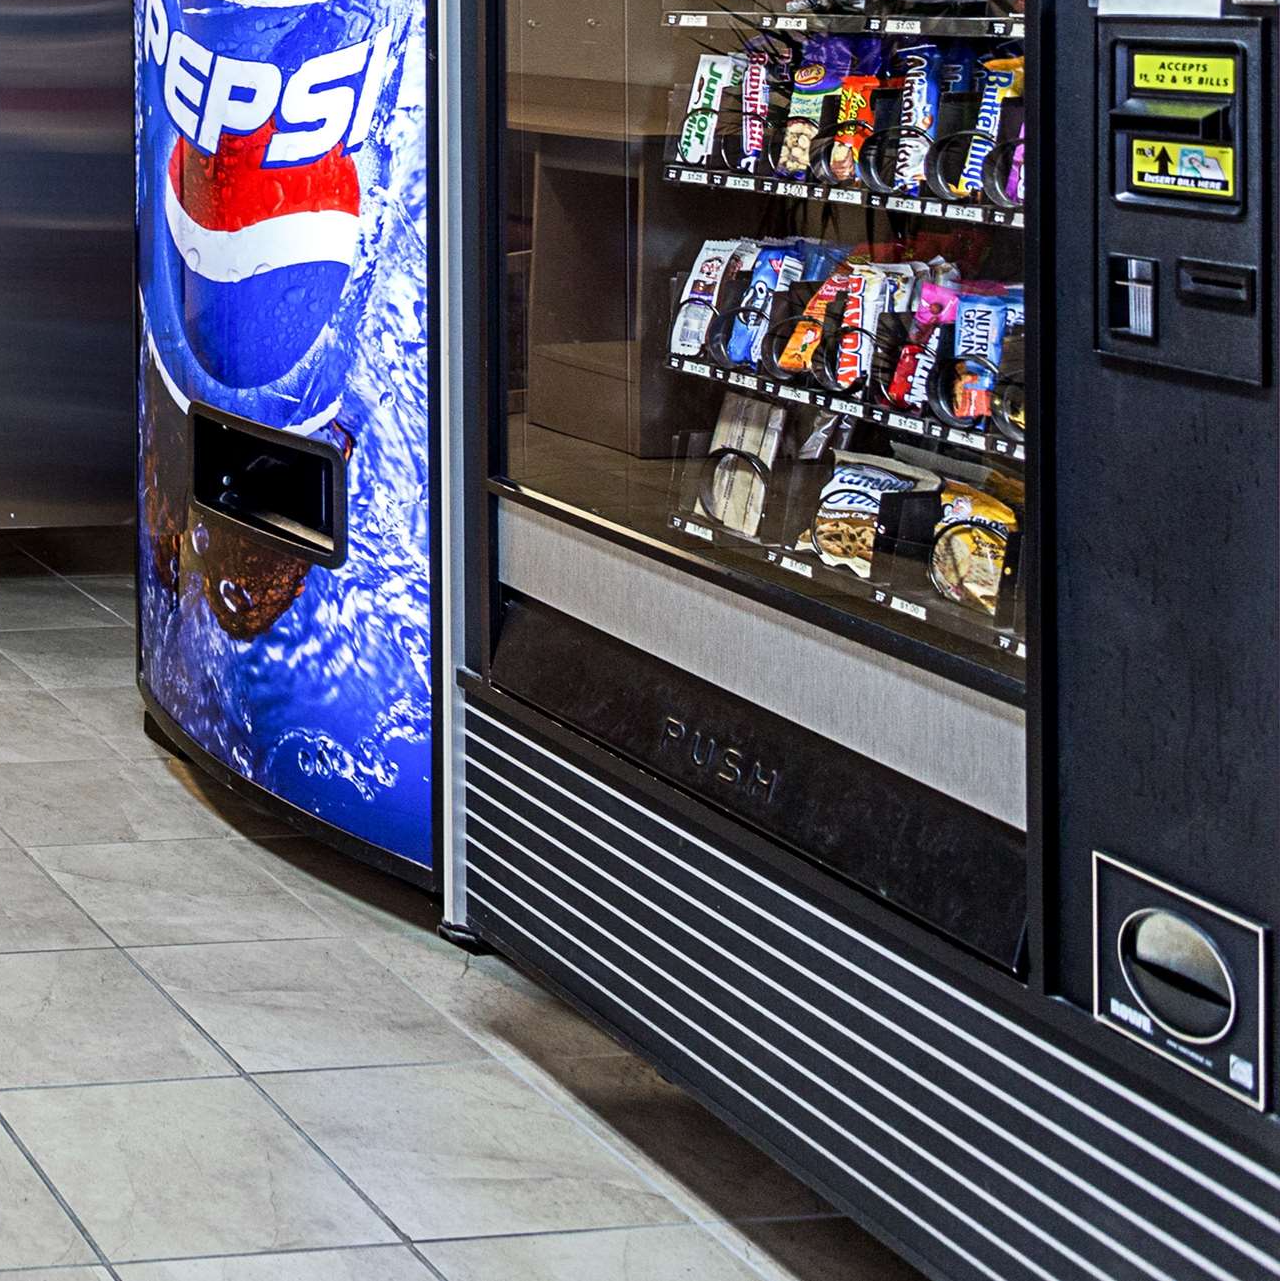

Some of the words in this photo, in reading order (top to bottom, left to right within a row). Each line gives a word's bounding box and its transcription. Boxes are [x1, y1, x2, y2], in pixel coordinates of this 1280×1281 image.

[895, 21, 915, 30] $1.00
[1158, 62, 1208, 72] ACCEPTS
[1156, 75, 1165, 84] $2
[1170, 75, 1178, 84] &
[1198, 77, 1229, 87] BILLS
[694, 62, 722, 145] Junior
[687, 172, 703, 181] $1.25
[1144, 173, 1176, 186] INSERT
[1177, 175, 1196, 188] BILL
[1197, 177, 1222, 190] HERE
[733, 179, 750, 187] $1.25
[836, 191, 855, 200] $1.25
[894, 199, 915, 210] $1.25
[955, 208, 976, 218] $1.25
[836, 274, 865, 389] PAYDAY
[960, 308, 977, 355] GRAIN
[839, 403, 858, 413] $1.25
[898, 418, 919, 430] $1.25
[659, 716, 779, 804] PUSH
